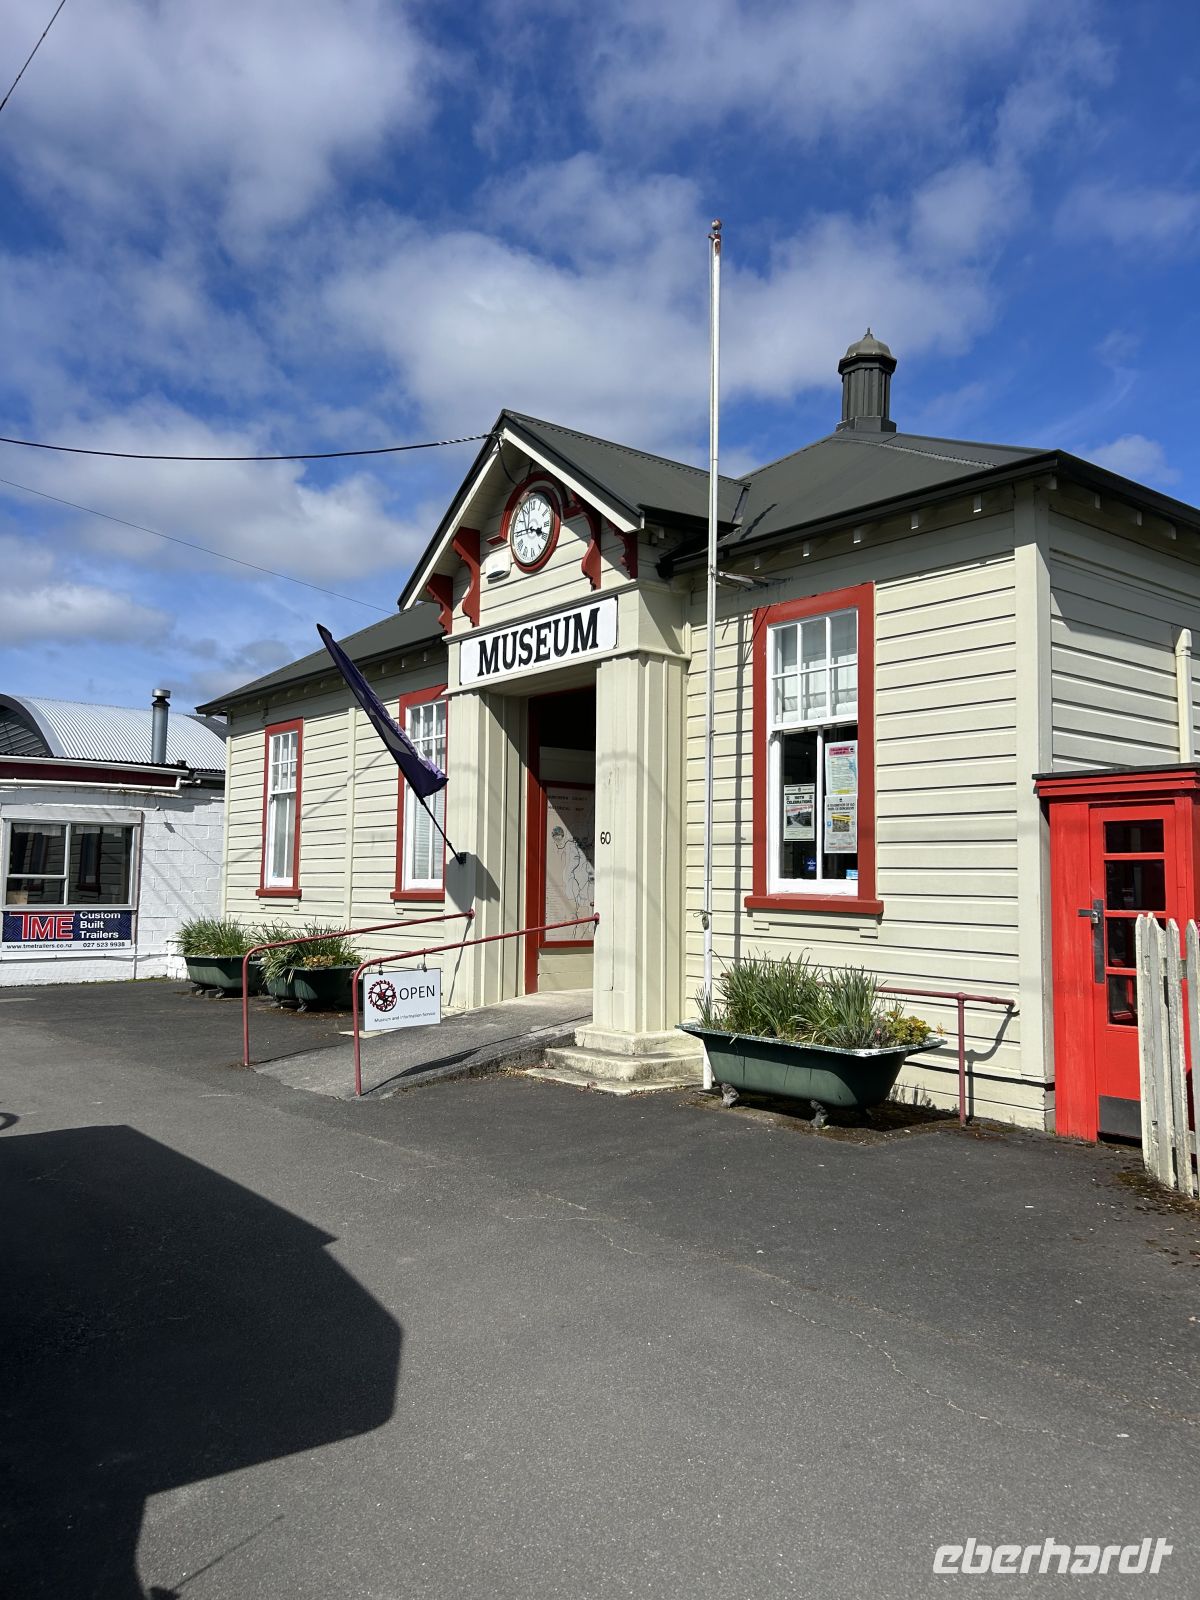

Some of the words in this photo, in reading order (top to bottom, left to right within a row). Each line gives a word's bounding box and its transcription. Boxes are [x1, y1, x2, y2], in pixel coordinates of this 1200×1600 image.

[477, 606, 601, 677] MUSEUM
[600, 831, 611, 845] 60
[80, 911, 121, 919] Custom
[9, 911, 75, 940] TME
[80, 920, 104, 929] Built
[80, 930, 119, 939] Trailers
[399, 985, 435, 1000] OPEN
